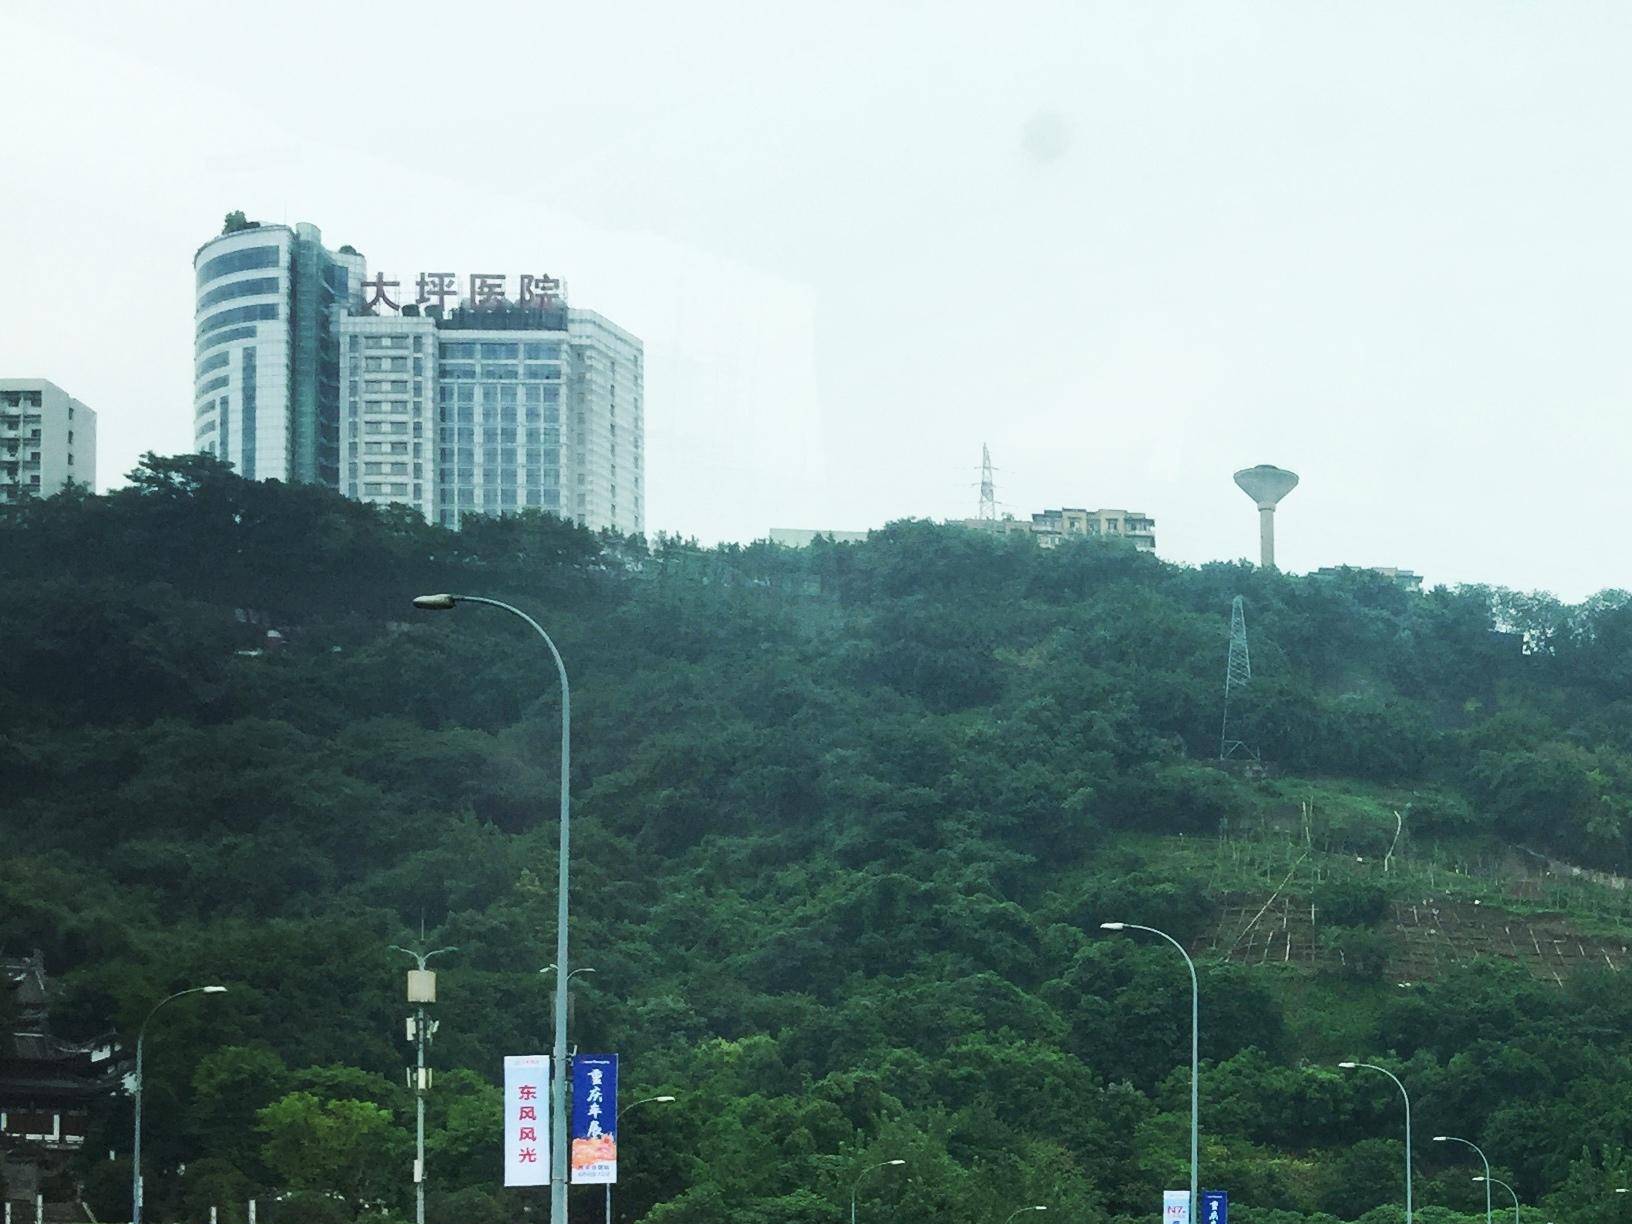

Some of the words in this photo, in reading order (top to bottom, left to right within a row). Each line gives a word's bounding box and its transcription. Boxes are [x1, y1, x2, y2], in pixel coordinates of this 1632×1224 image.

[361, 271, 560, 312] 大坪医院
[519, 1085, 537, 1163] 东风风光
